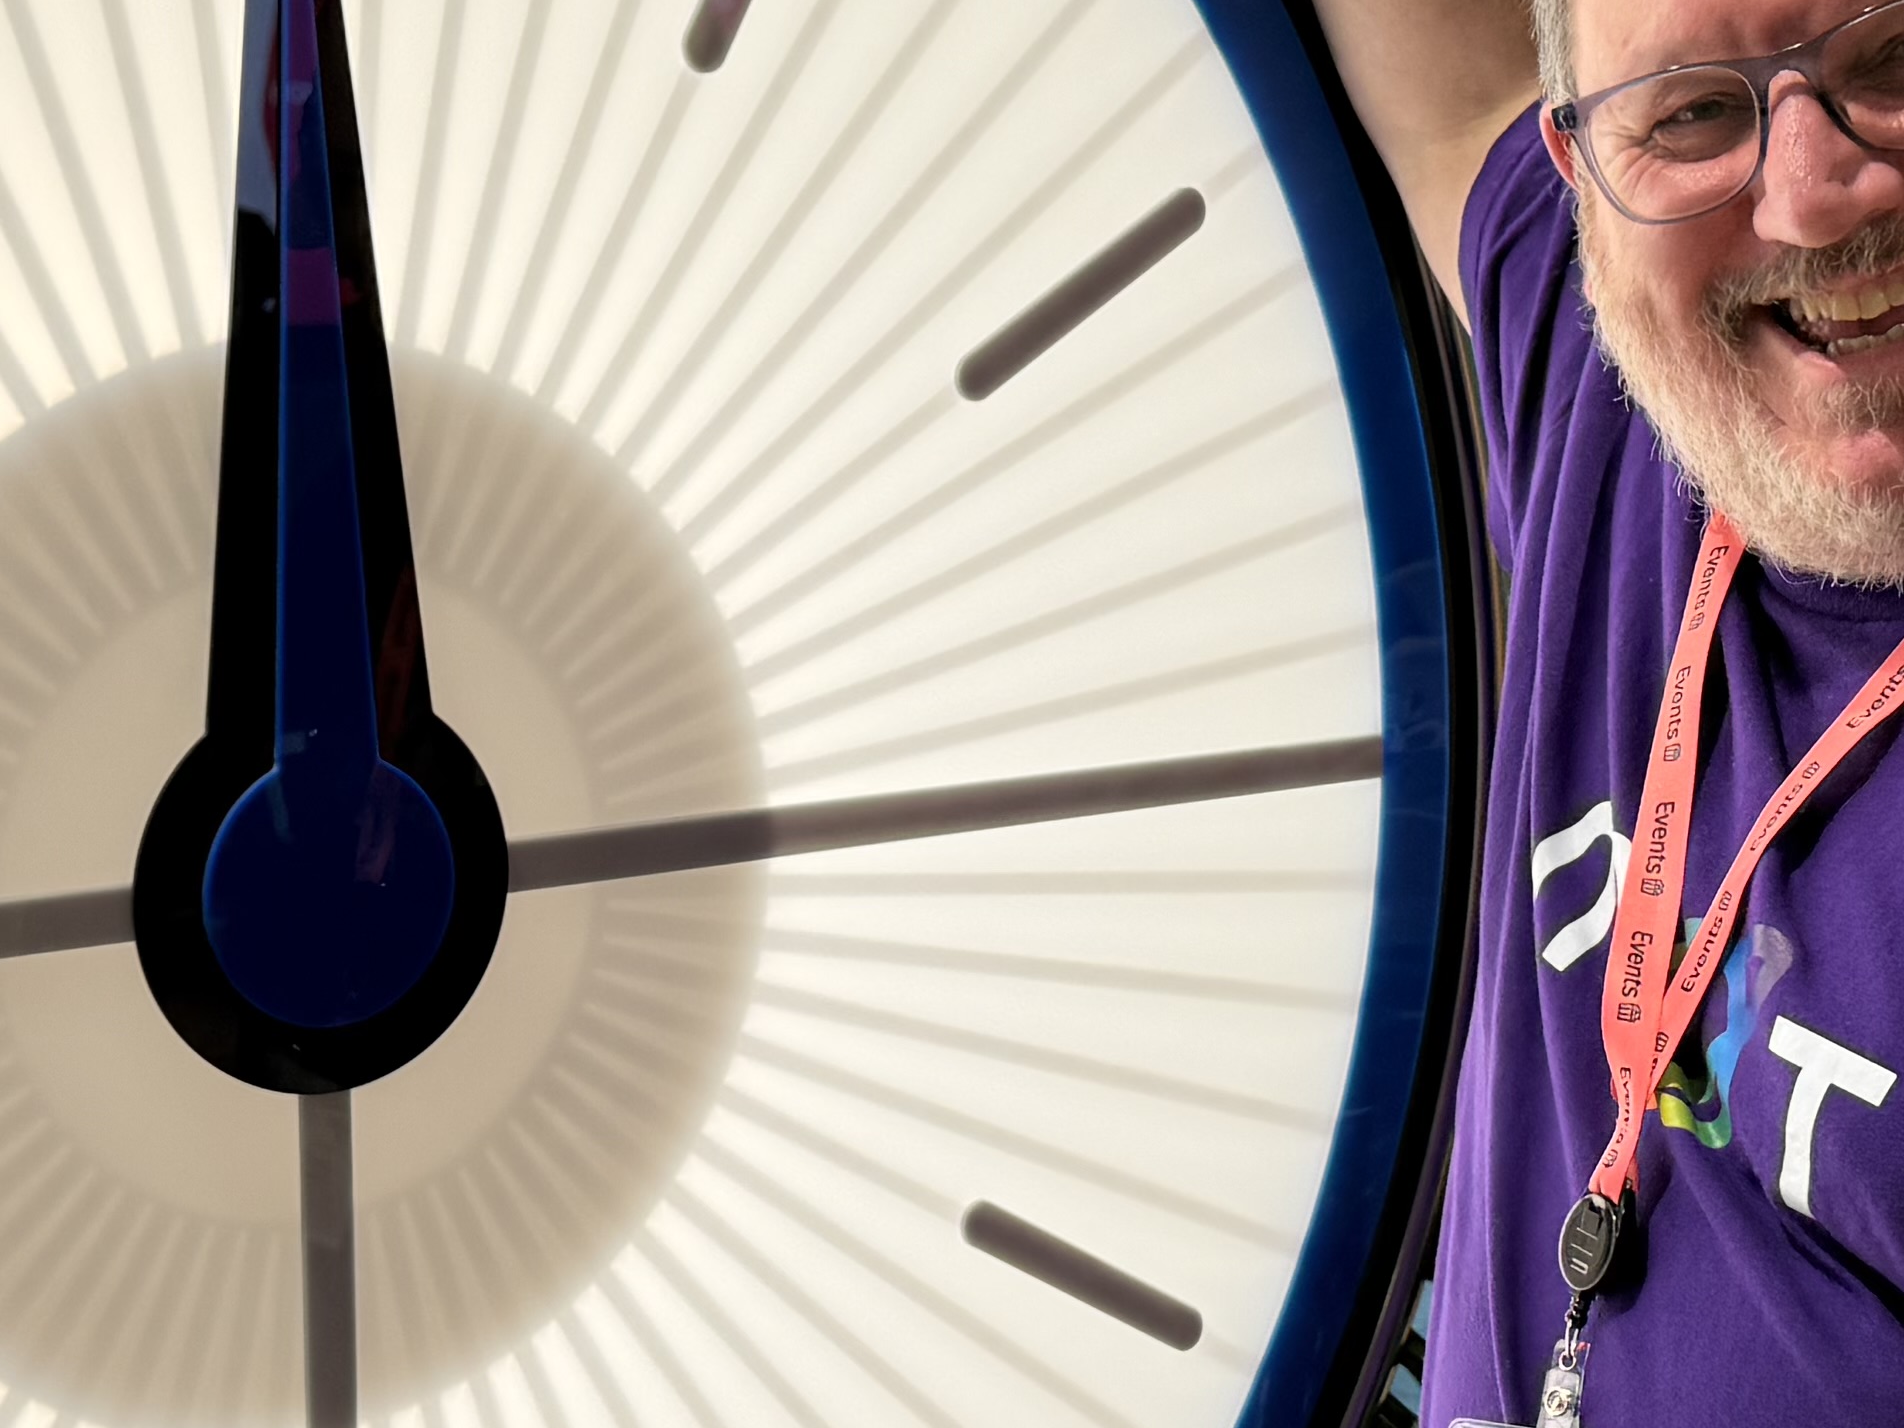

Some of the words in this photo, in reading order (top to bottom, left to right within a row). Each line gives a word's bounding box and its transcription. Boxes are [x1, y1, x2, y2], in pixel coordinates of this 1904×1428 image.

[1694, 544, 1730, 611] Events
[1666, 664, 1692, 739] Events
[1645, 800, 1676, 875] Events
[1749, 782, 1803, 852] Events
[1621, 930, 1654, 999] Events
[1680, 915, 1724, 993] Events
